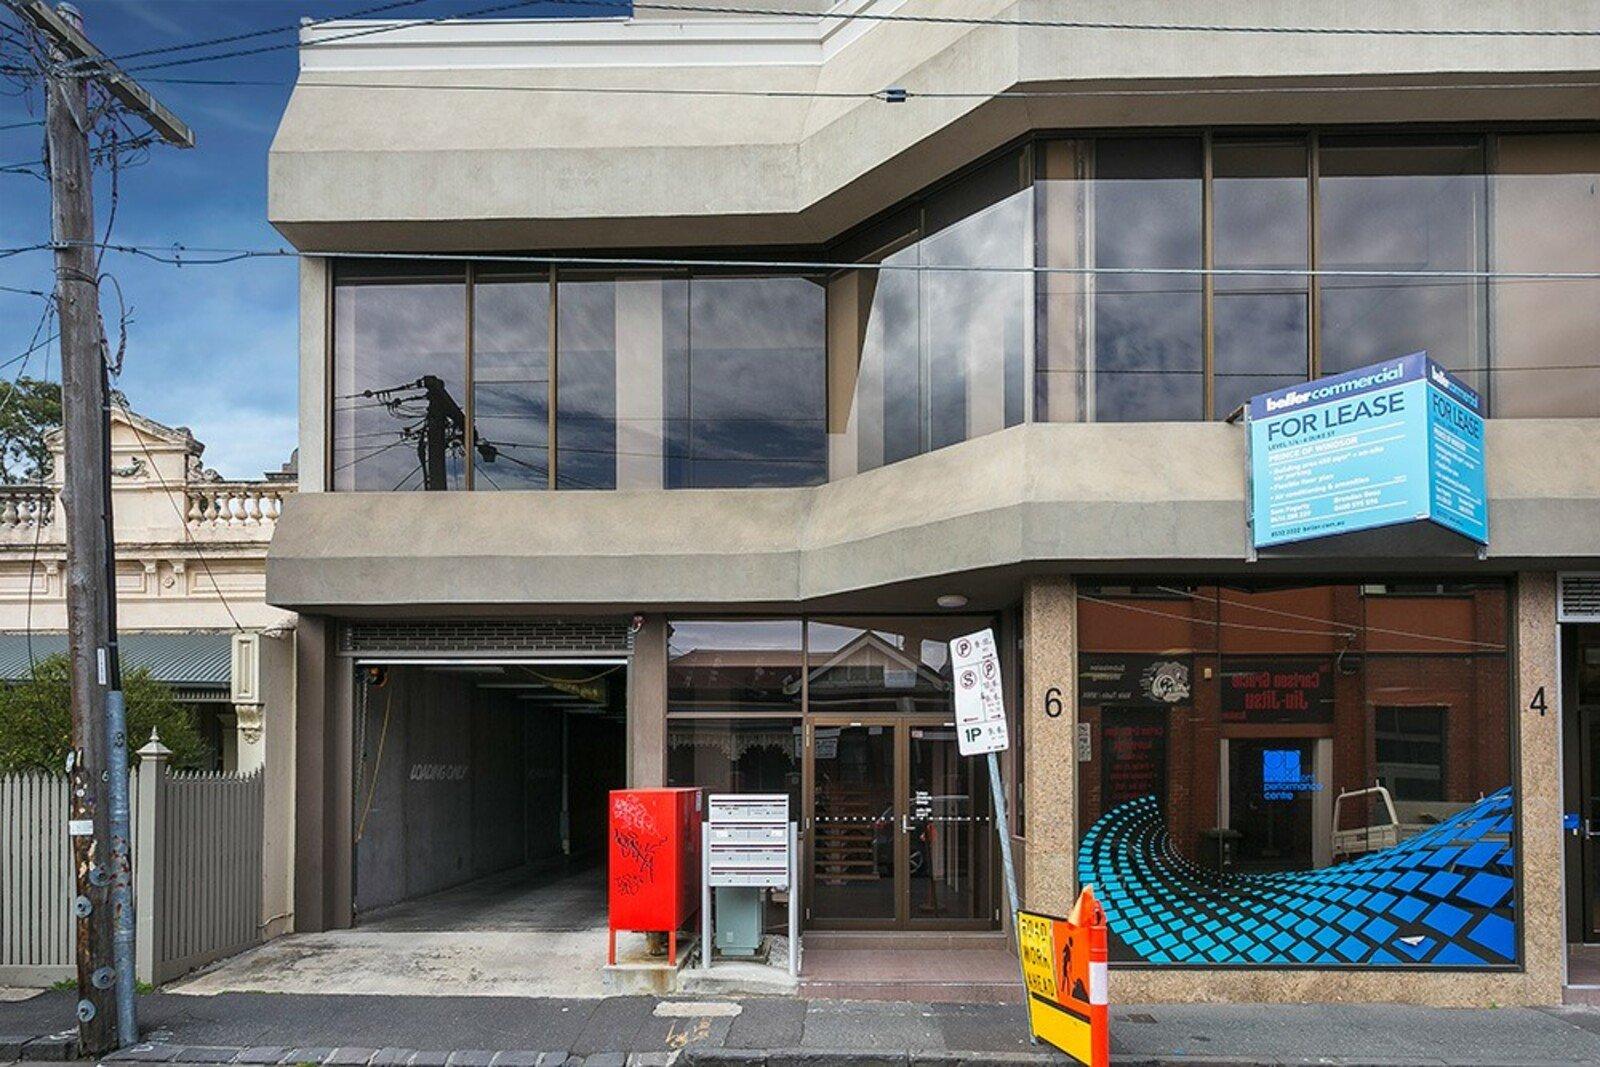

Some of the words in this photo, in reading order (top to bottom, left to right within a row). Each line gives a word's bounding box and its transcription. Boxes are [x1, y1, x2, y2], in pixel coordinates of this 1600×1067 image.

[1268, 414, 1316, 441] FOR
[1325, 392, 1404, 428] LEASE
[1433, 394, 1451, 424] FOR
[1451, 406, 1480, 439] LEASE
[1045, 687, 1062, 718] 6
[1530, 686, 1548, 716] 4
[966, 728, 982, 742] 1P
